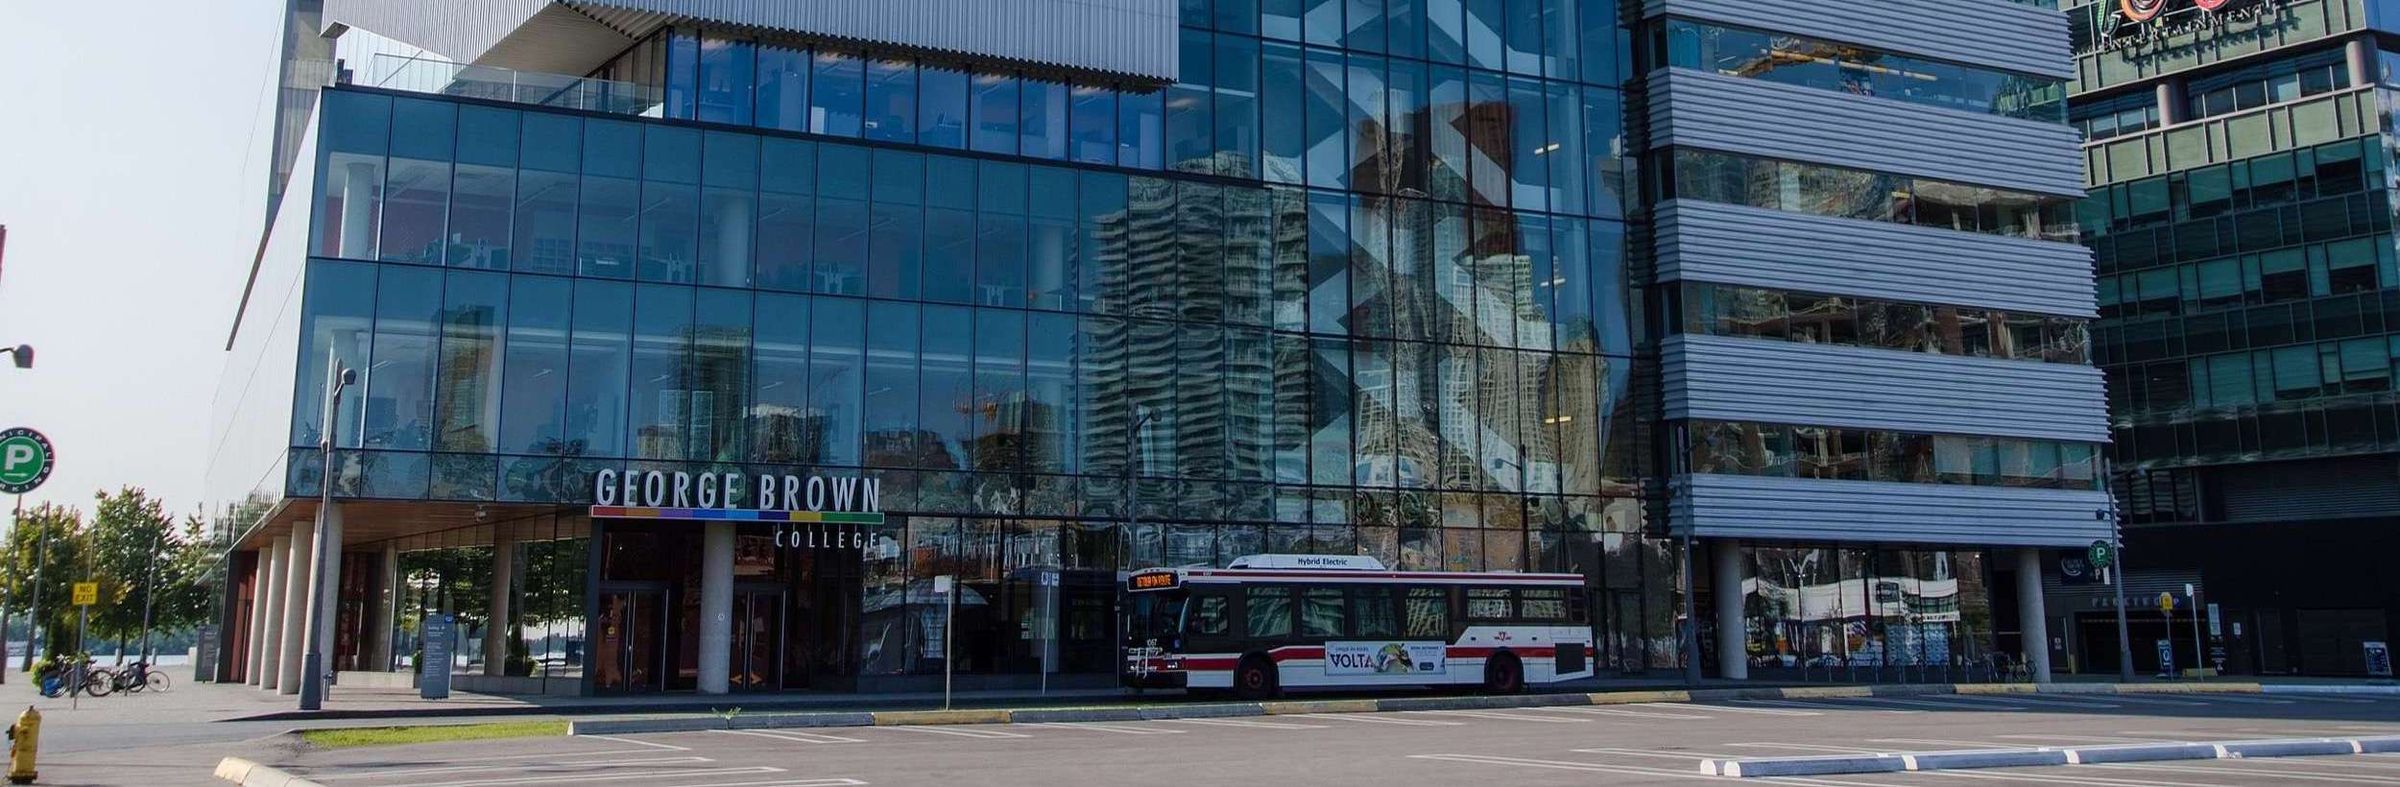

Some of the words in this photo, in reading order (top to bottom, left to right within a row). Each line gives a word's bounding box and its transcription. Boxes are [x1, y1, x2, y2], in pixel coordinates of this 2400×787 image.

[5, 445, 34, 470] P
[596, 468, 738, 510] GEORGE
[759, 473, 880, 513] BROWN
[775, 530, 878, 550] COLLEGE
[2096, 547, 2106, 559] P
[1297, 558, 1320, 566] Hybrid
[1322, 558, 1348, 566] Electric
[79, 585, 92, 593] NO
[75, 594, 94, 602] EXIT
[1330, 653, 1374, 668] VOLTA
